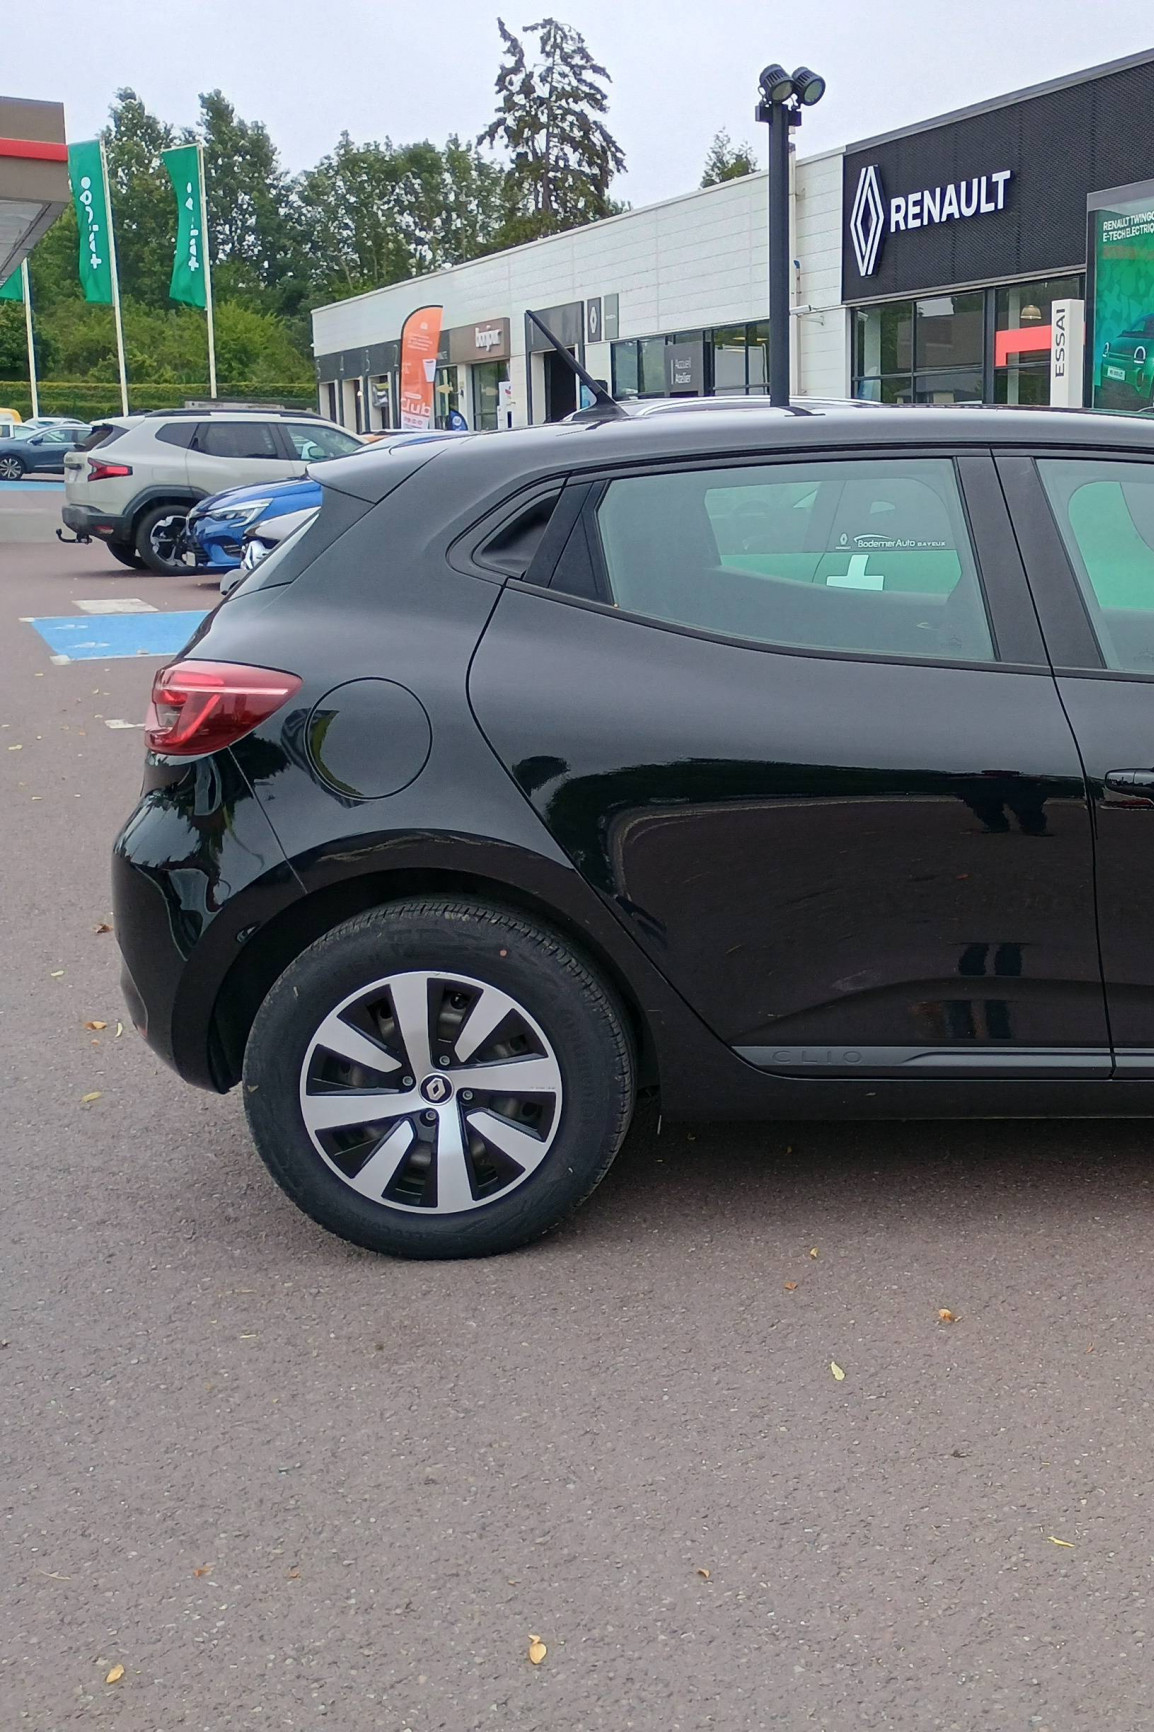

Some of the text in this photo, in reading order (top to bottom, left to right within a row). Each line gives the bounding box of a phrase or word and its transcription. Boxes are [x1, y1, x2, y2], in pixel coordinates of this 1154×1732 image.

[890, 170, 1011, 233] RENAULT
[1103, 214, 1129, 231] RENAULT
[1055, 308, 1066, 378] ESSAI
[772, 1050, 863, 1065] CLIO
